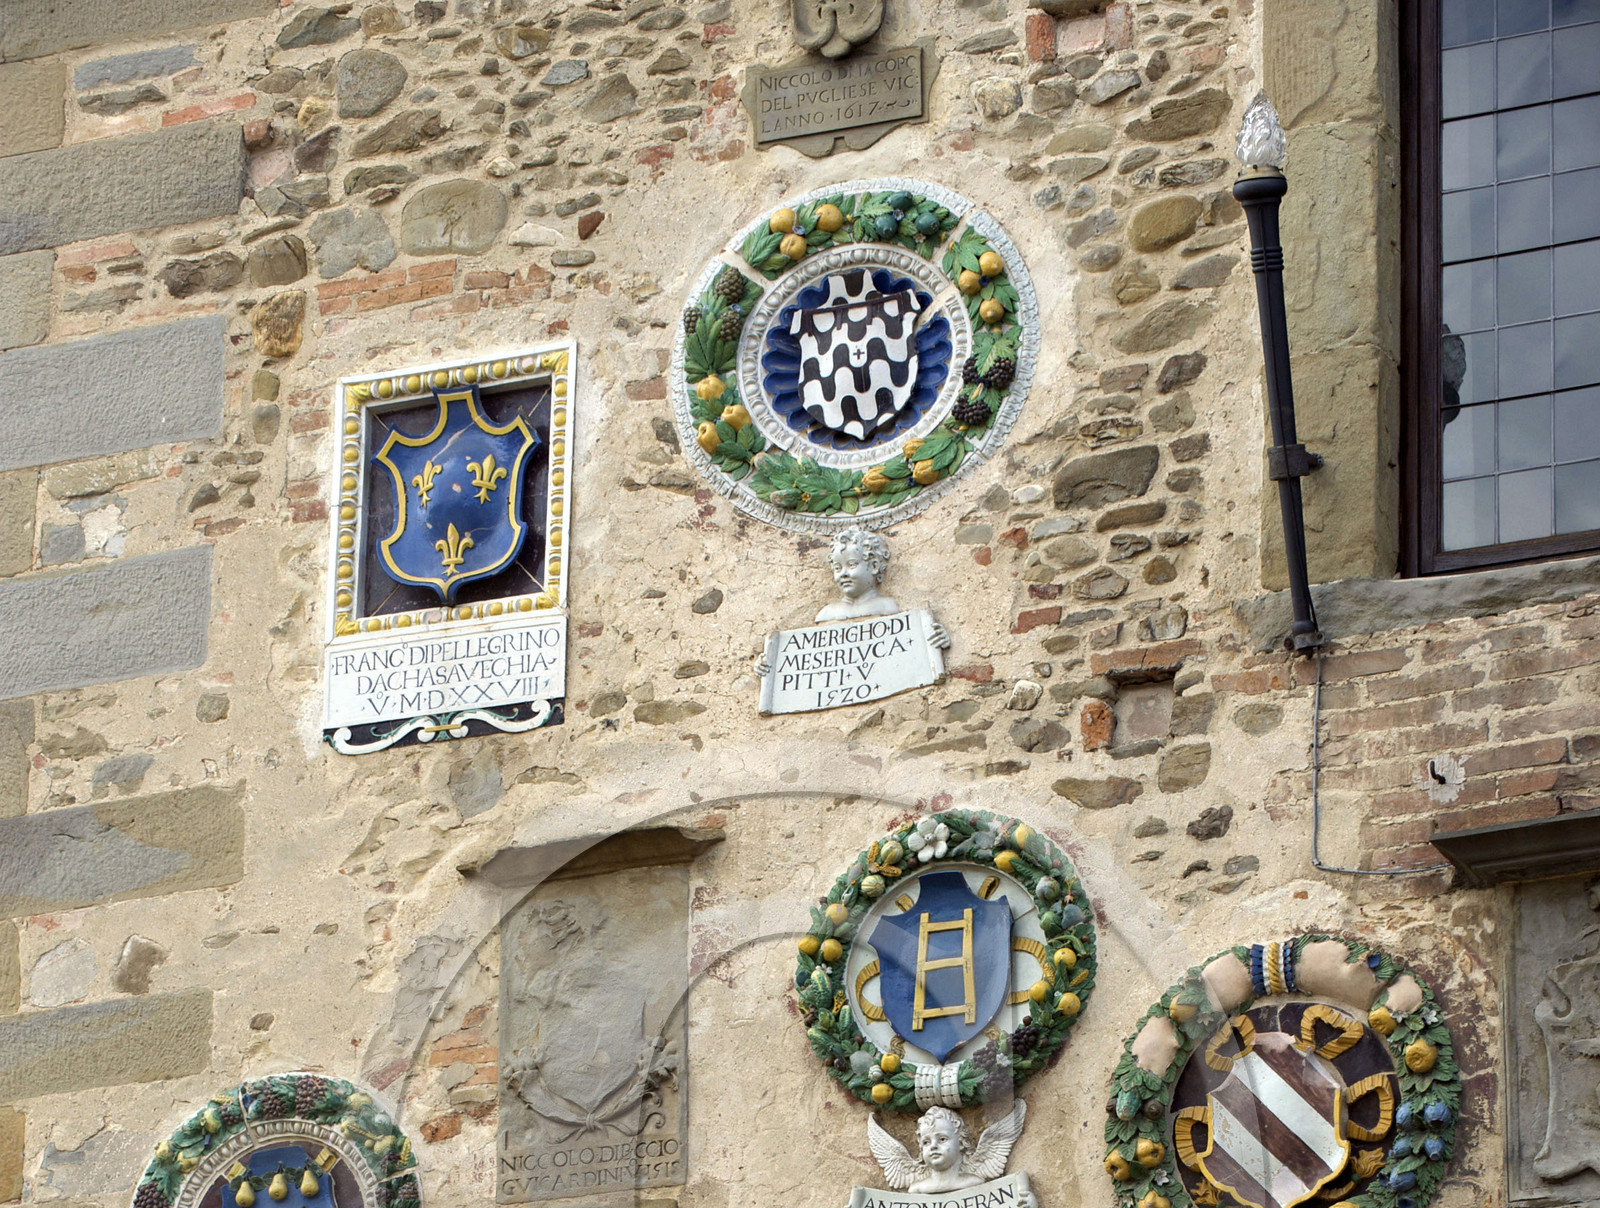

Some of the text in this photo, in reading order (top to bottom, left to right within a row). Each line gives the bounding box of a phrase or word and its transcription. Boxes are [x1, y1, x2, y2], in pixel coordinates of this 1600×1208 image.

[759, 69, 832, 93] NICCOLO
[761, 96, 792, 114] DEL
[797, 82, 877, 107] PVGLIESE
[762, 102, 879, 134] LANNO 1617
[782, 615, 911, 652] AMERIGHO DI
[782, 669, 846, 691] PITTI
[817, 684, 872, 708] 1520
[501, 1148, 595, 1175] NICCOLO
